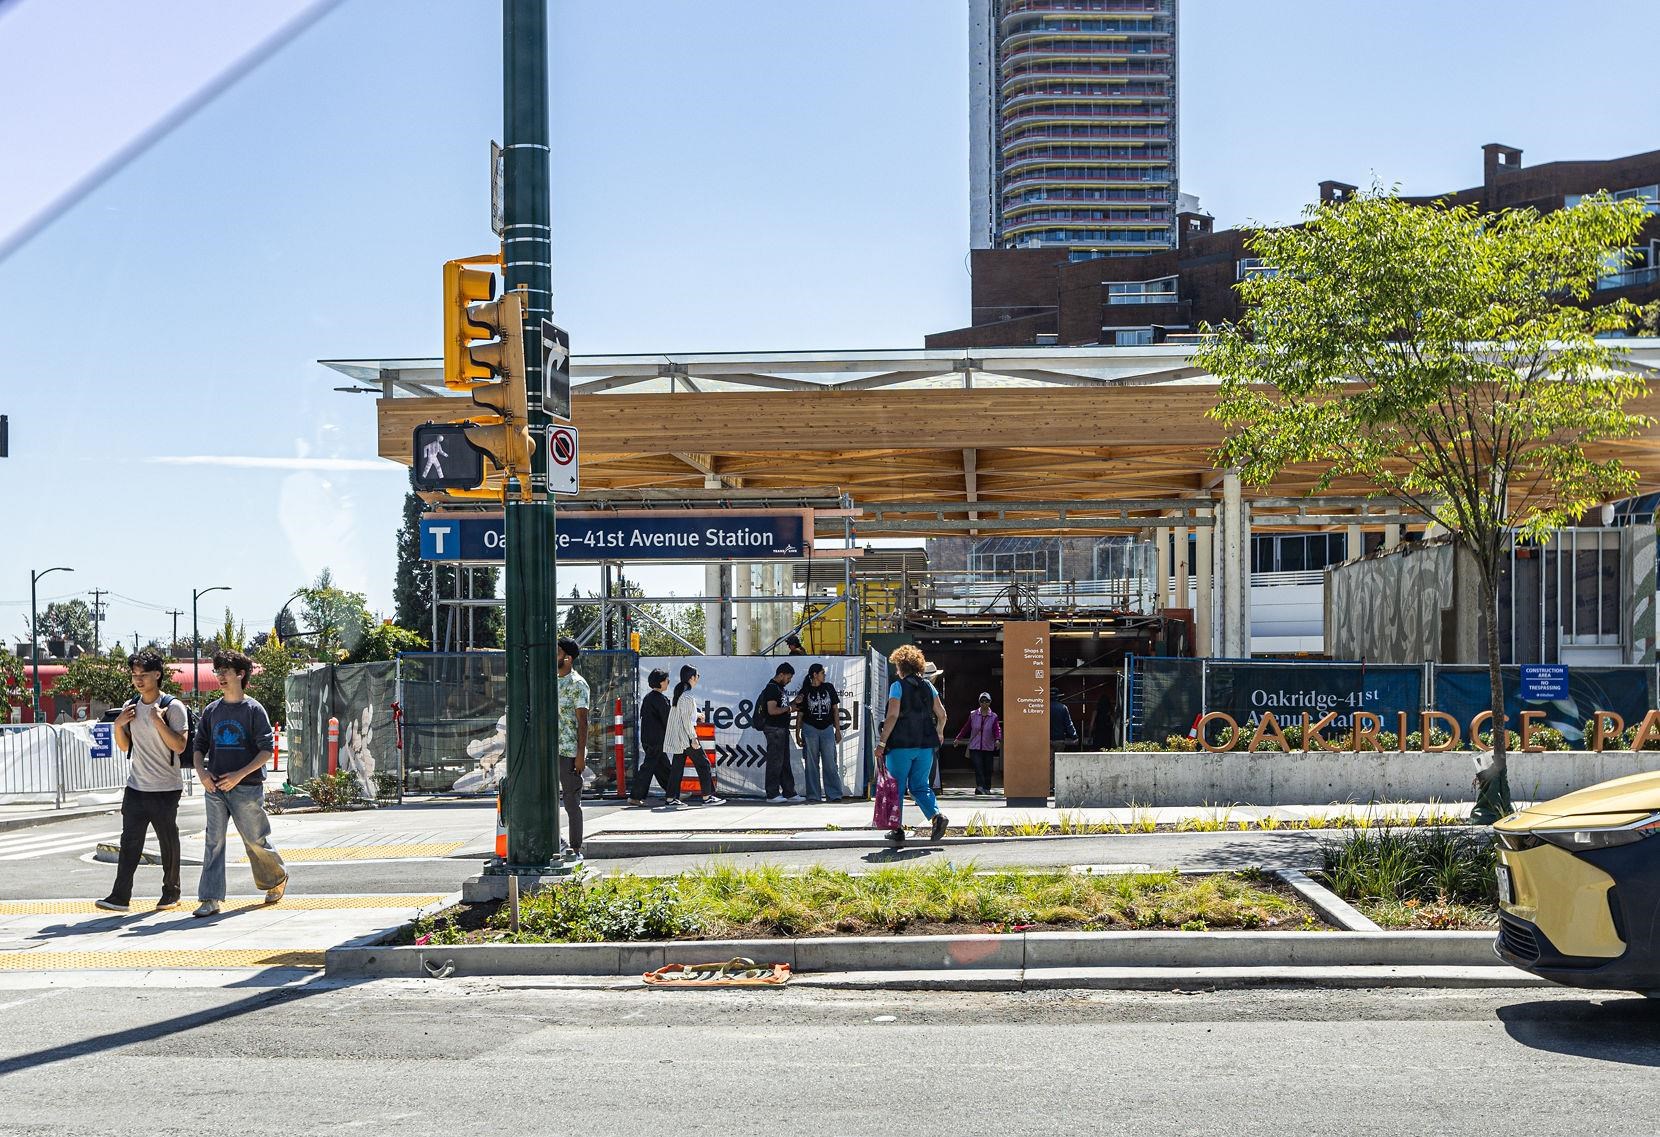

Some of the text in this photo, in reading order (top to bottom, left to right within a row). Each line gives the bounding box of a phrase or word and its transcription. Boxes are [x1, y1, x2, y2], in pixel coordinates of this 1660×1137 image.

[429, 527, 451, 554] T
[629, 529, 699, 547] Avenue
[705, 527, 774, 546] Station
[1251, 688, 1379, 711] Oakridge-41st
[1198, 710, 1547, 753] OAKRIDGE
